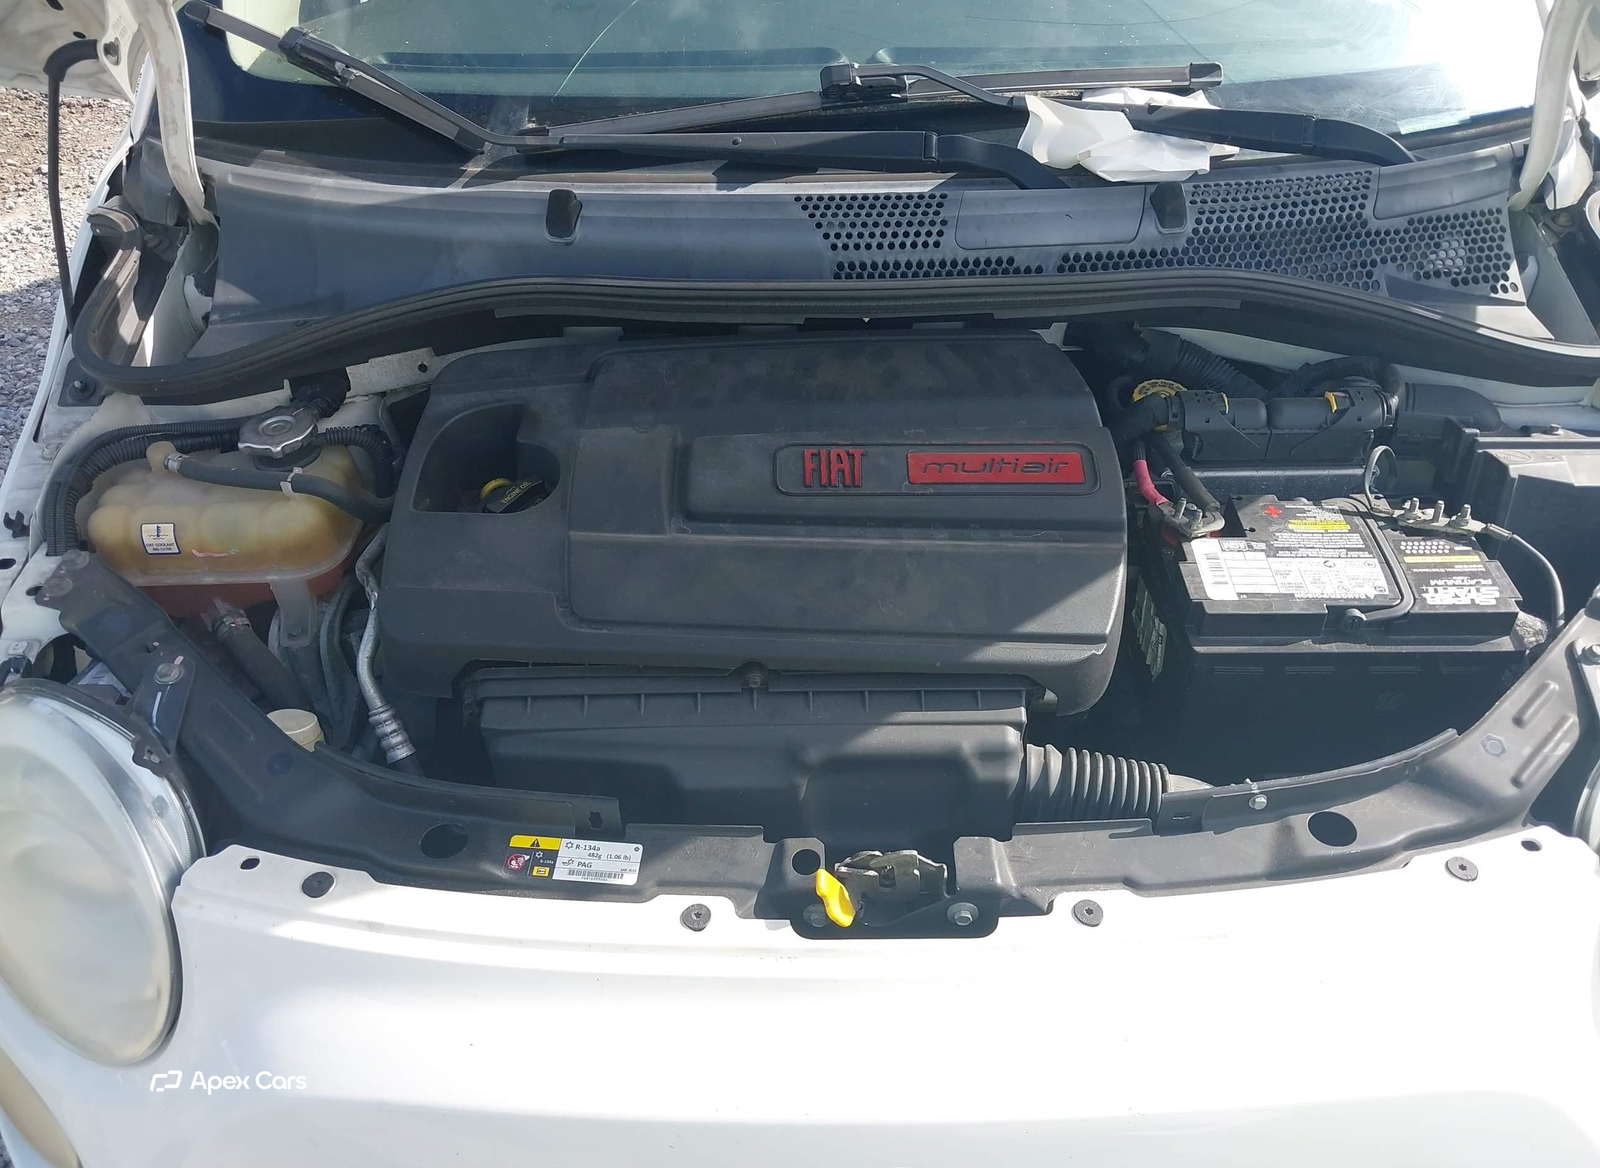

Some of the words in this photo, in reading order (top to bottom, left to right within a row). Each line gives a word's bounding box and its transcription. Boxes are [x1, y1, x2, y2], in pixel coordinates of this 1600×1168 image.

[803, 448, 866, 487] FIAT
[922, 457, 1070, 475] multiair
[501, 487, 523, 504] ENGINE
[1429, 578, 1493, 586] PLATINUM
[1427, 586, 1500, 598] START
[1427, 595, 1497, 606] SUPER
[575, 843, 601, 852] R-134a
[587, 852, 602, 860] 482g
[606, 853, 622, 861] (1.06
[622, 854, 632, 862] lb)
[576, 861, 593, 869] PAG
